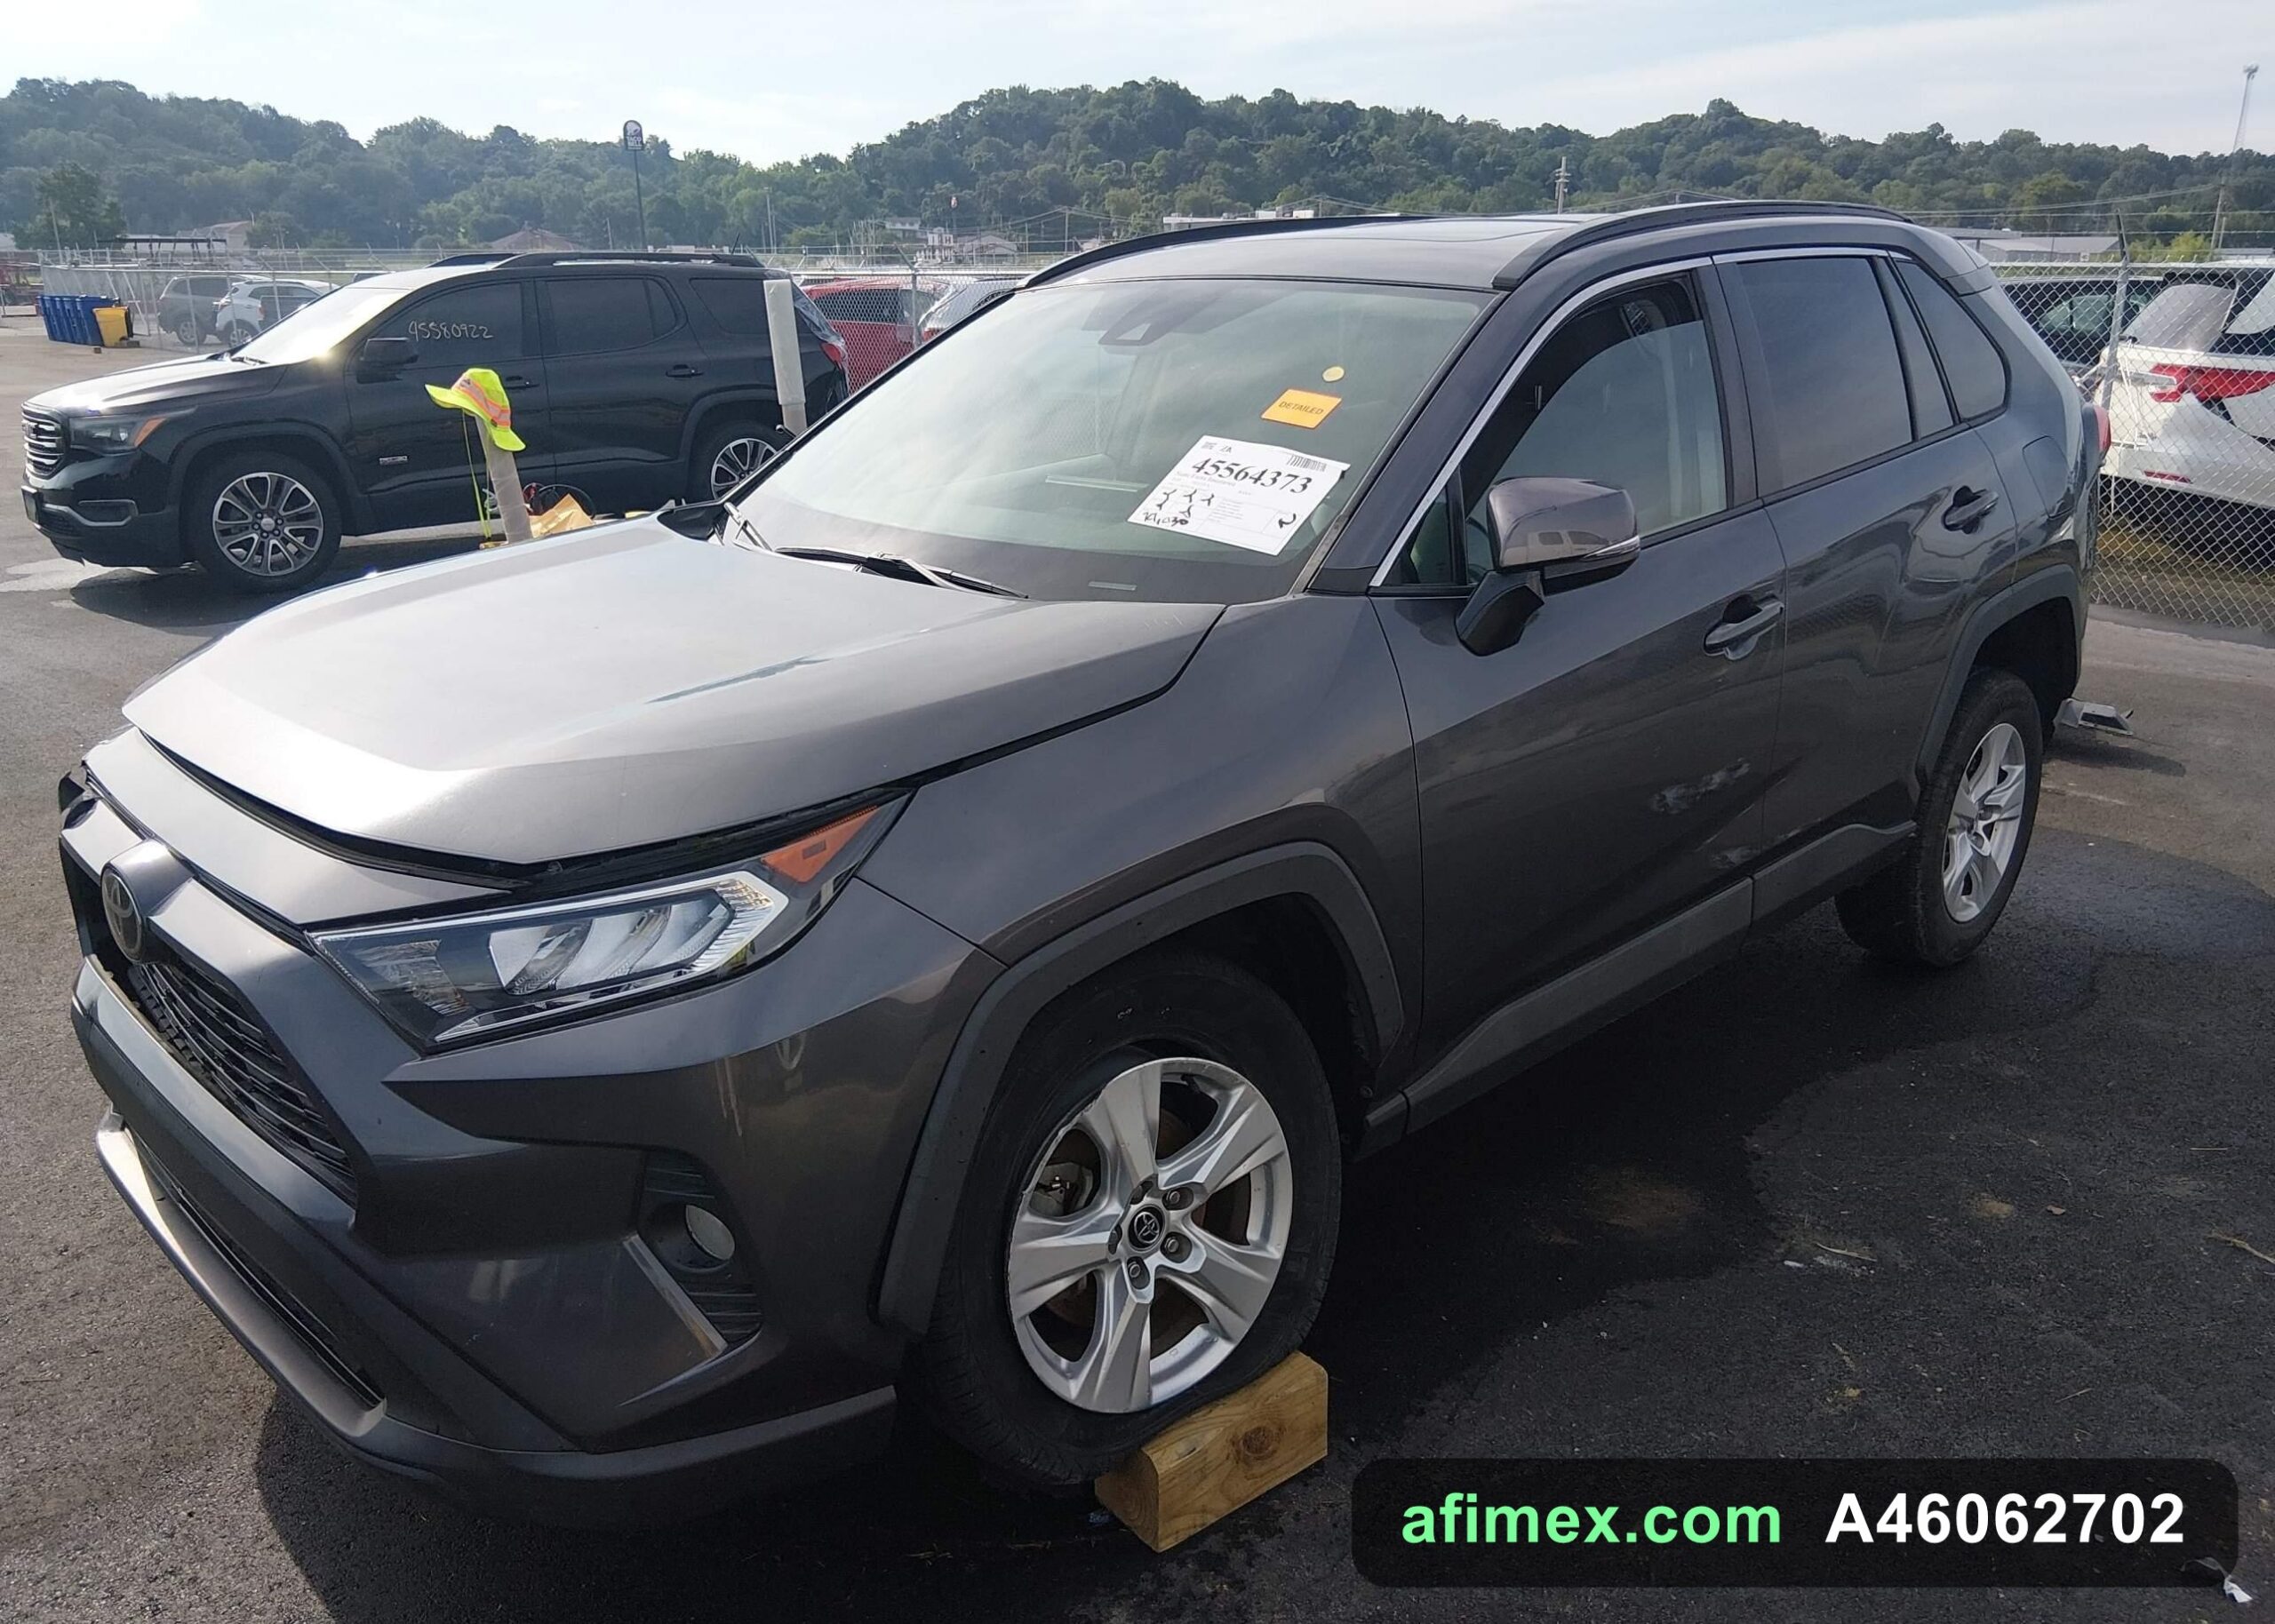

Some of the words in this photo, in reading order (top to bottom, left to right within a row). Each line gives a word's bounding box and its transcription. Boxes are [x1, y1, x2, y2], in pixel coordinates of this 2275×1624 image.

[409, 320, 495, 341] 45580922
[1278, 401, 1324, 415] DETAILED
[1192, 458, 1313, 493] 45564373
